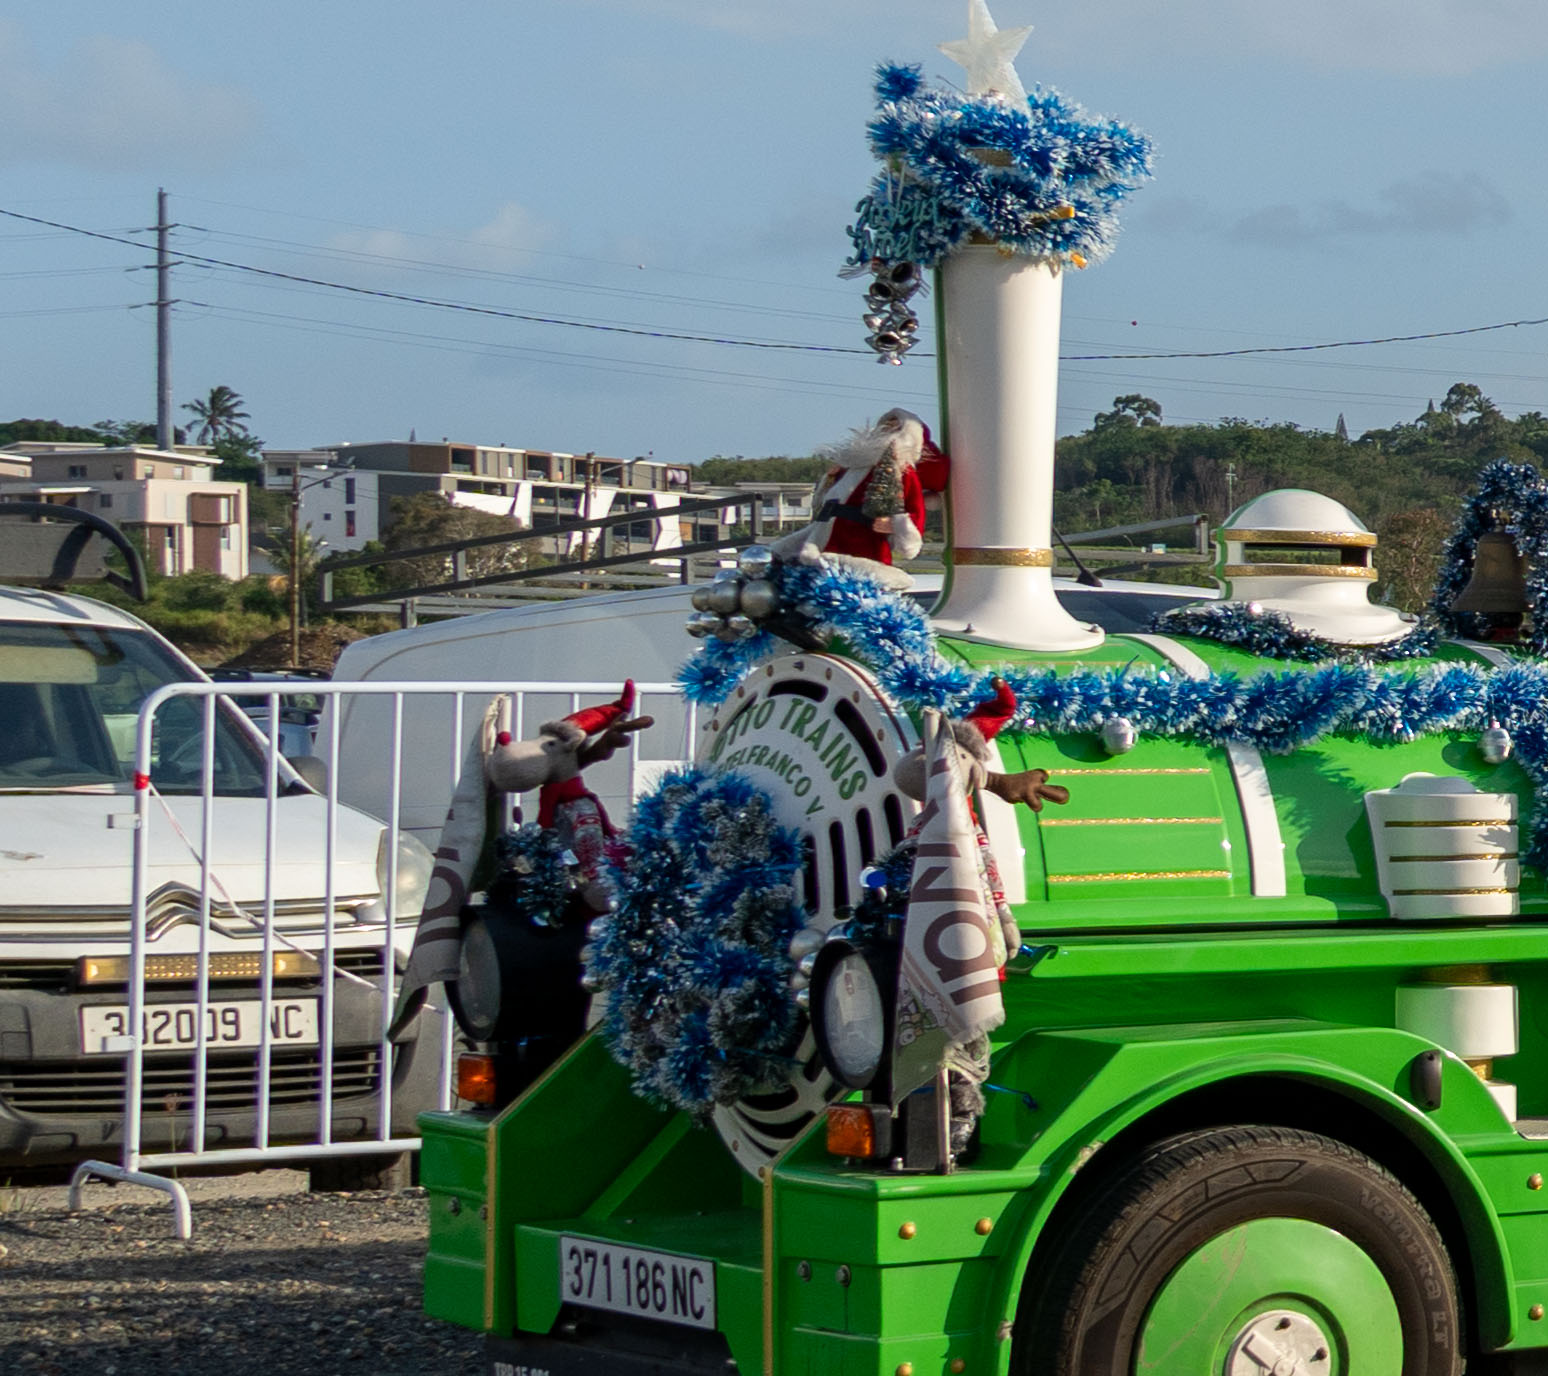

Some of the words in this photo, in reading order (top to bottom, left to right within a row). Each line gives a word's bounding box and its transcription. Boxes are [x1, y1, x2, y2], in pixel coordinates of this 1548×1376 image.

[779, 697, 868, 801] TRAINS
[568, 1245, 612, 1303] 371
[622, 1255, 667, 1313] 186
[671, 1264, 706, 1321] NC
